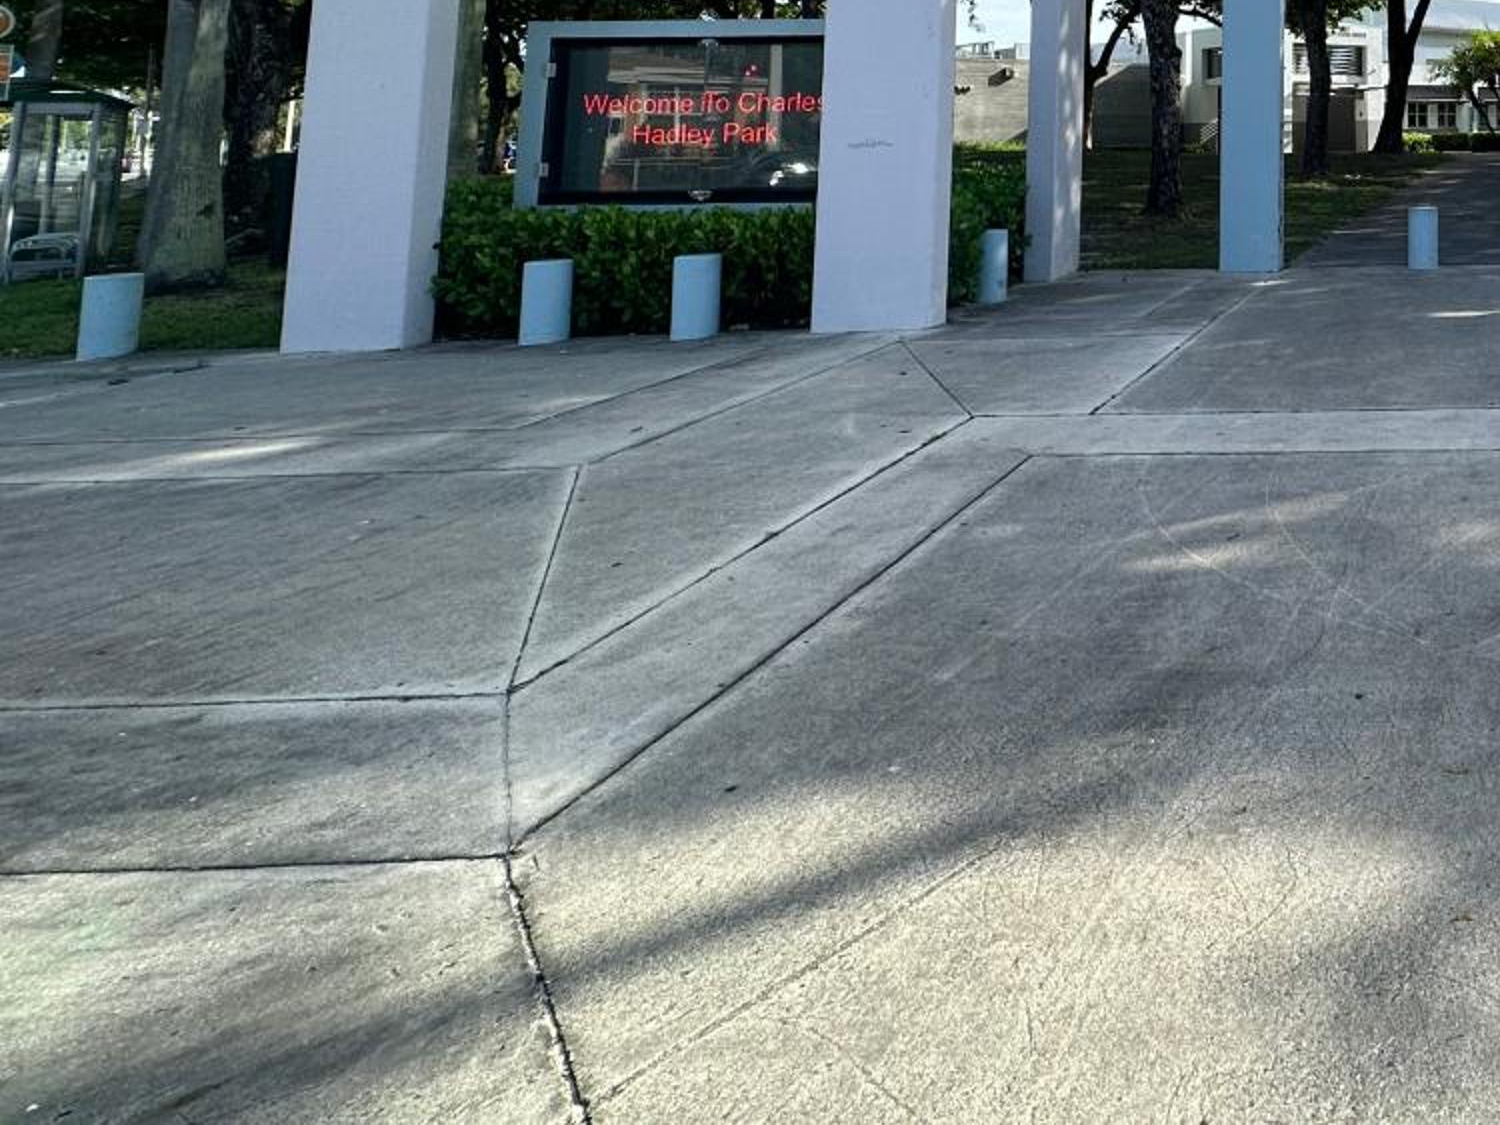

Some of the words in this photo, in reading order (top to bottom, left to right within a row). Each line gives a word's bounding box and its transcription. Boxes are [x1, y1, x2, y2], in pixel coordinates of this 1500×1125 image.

[584, 92, 694, 115] Welcome
[701, 92, 730, 113] To
[632, 123, 714, 149] Hadley
[723, 122, 778, 144] Park
